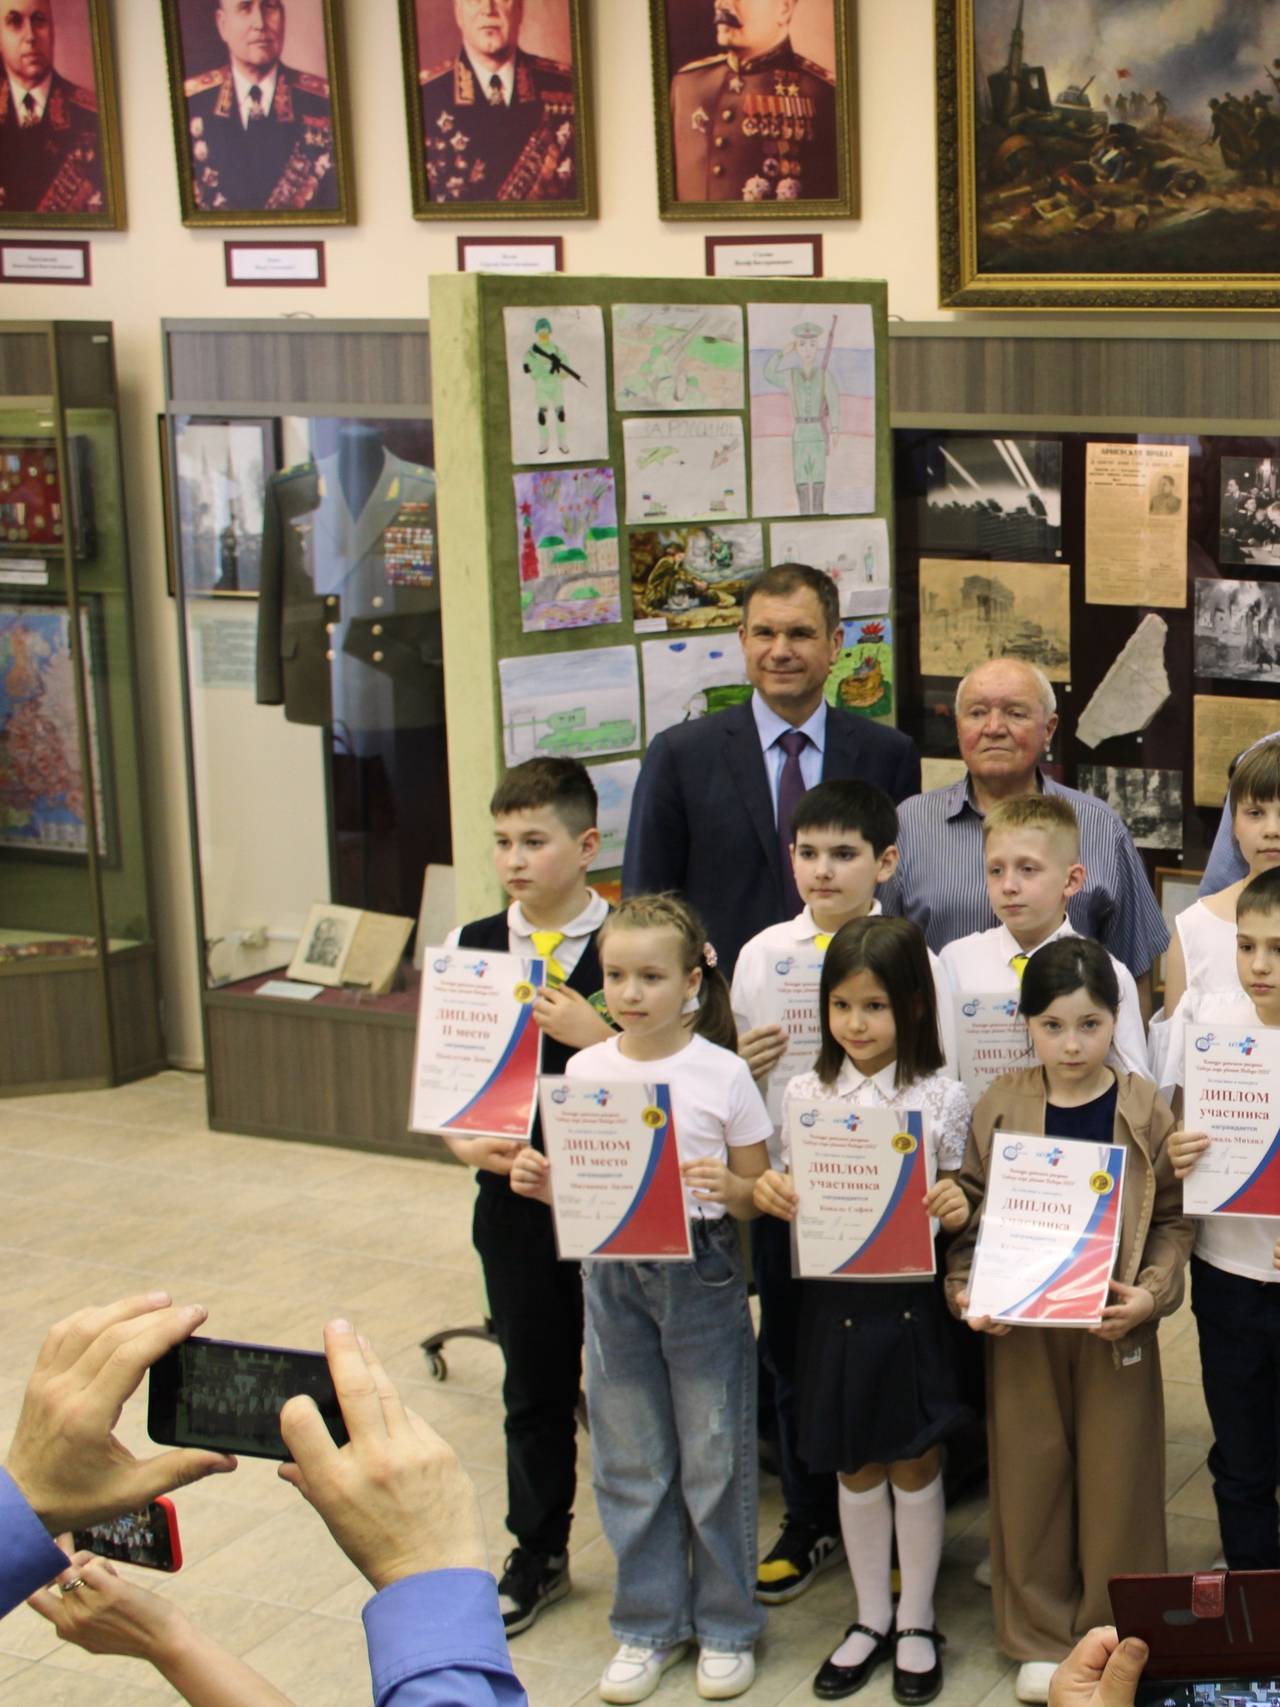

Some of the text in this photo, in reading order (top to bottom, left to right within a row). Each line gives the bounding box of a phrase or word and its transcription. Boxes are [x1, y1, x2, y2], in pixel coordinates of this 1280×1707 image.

[435, 1008, 500, 1025] ДИПЛОМ
[1199, 1087, 1270, 1104] ДИПЛОМ
[1199, 1107, 1270, 1121] участника
[561, 1138, 631, 1152] ДИПЛОМ
[590, 1158, 628, 1167] место
[808, 1161, 879, 1176] ДИПЛОМ
[809, 1179, 880, 1191] участника
[1002, 1197, 1072, 1216] ДИПЛОМ
